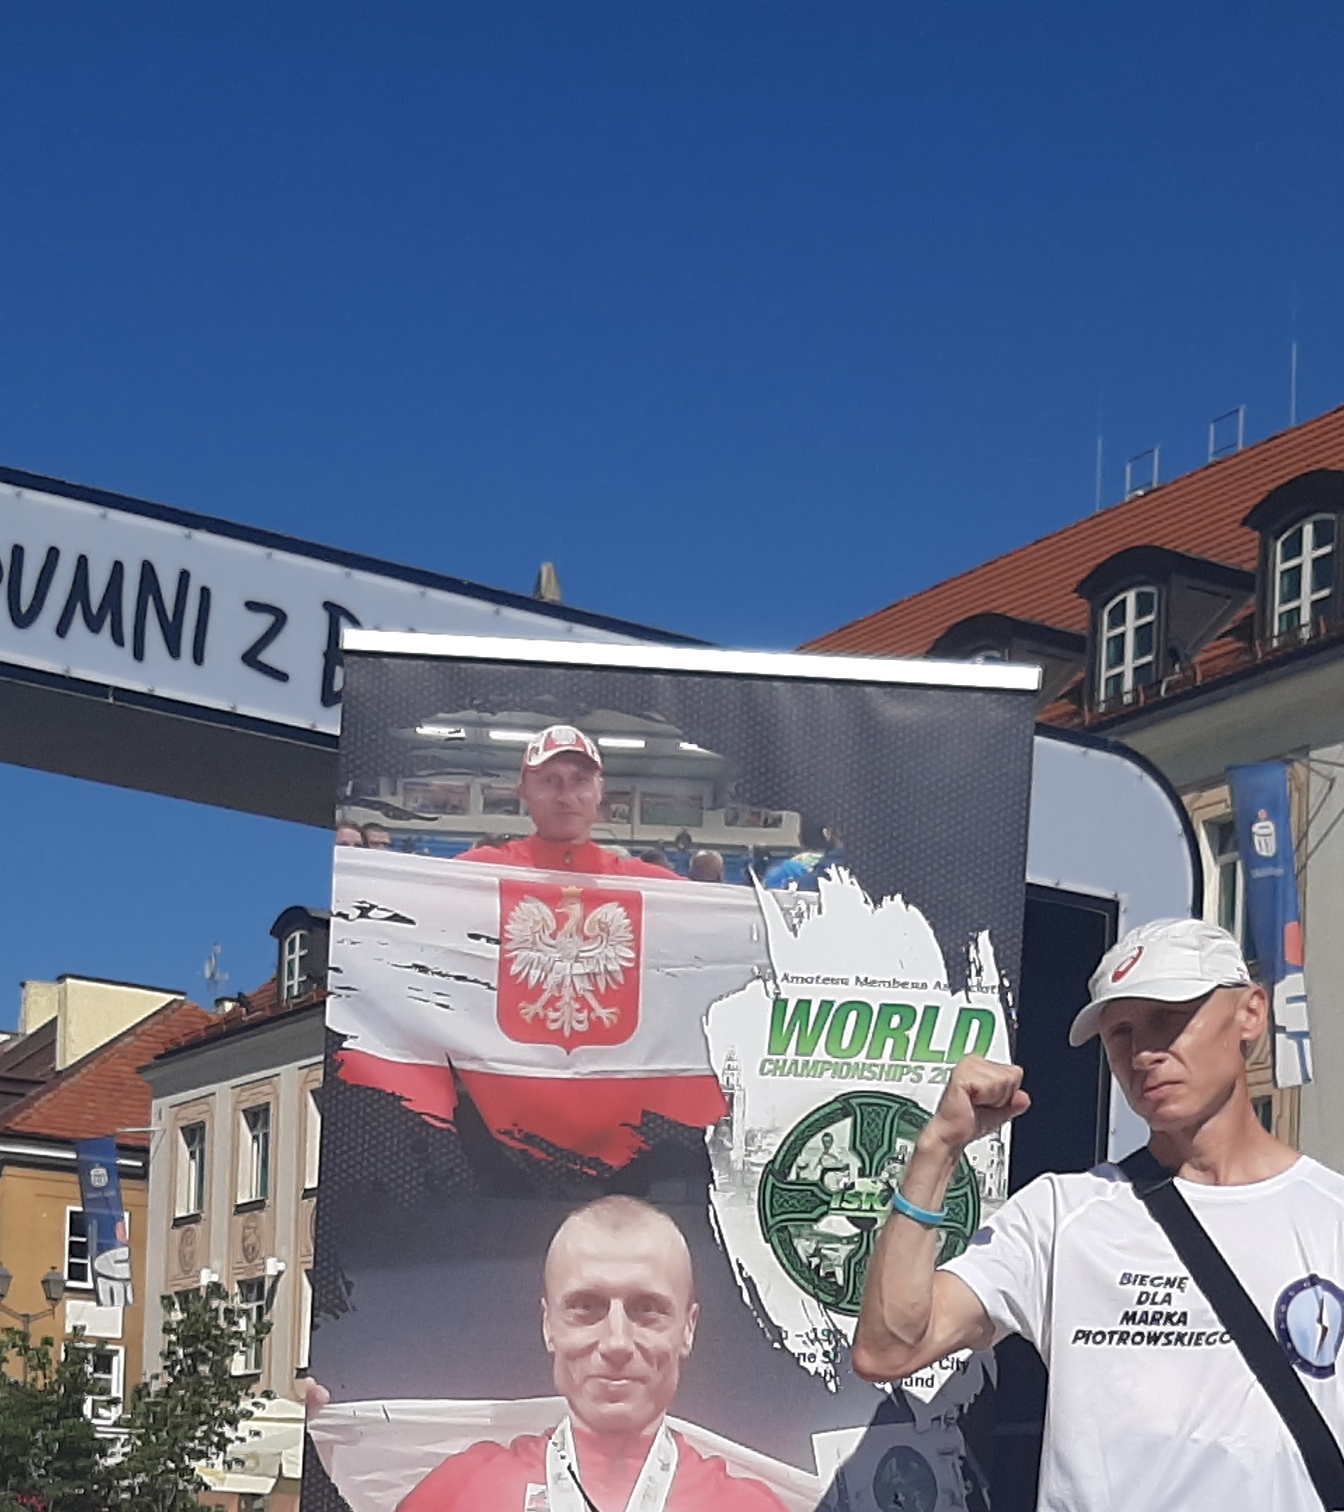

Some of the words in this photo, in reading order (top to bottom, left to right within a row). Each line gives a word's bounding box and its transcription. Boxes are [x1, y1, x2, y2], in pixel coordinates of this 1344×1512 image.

[241, 601, 289, 683] Z
[767, 997, 996, 1065] WORLD
[759, 1057, 924, 1084] CHAMPIONSHIPS
[830, 1189, 887, 1211] ISK
[1135, 1291, 1173, 1306] DLA
[1119, 1310, 1189, 1326] MARKA
[1071, 1329, 1235, 1347] PIOTROWSKIEGO
